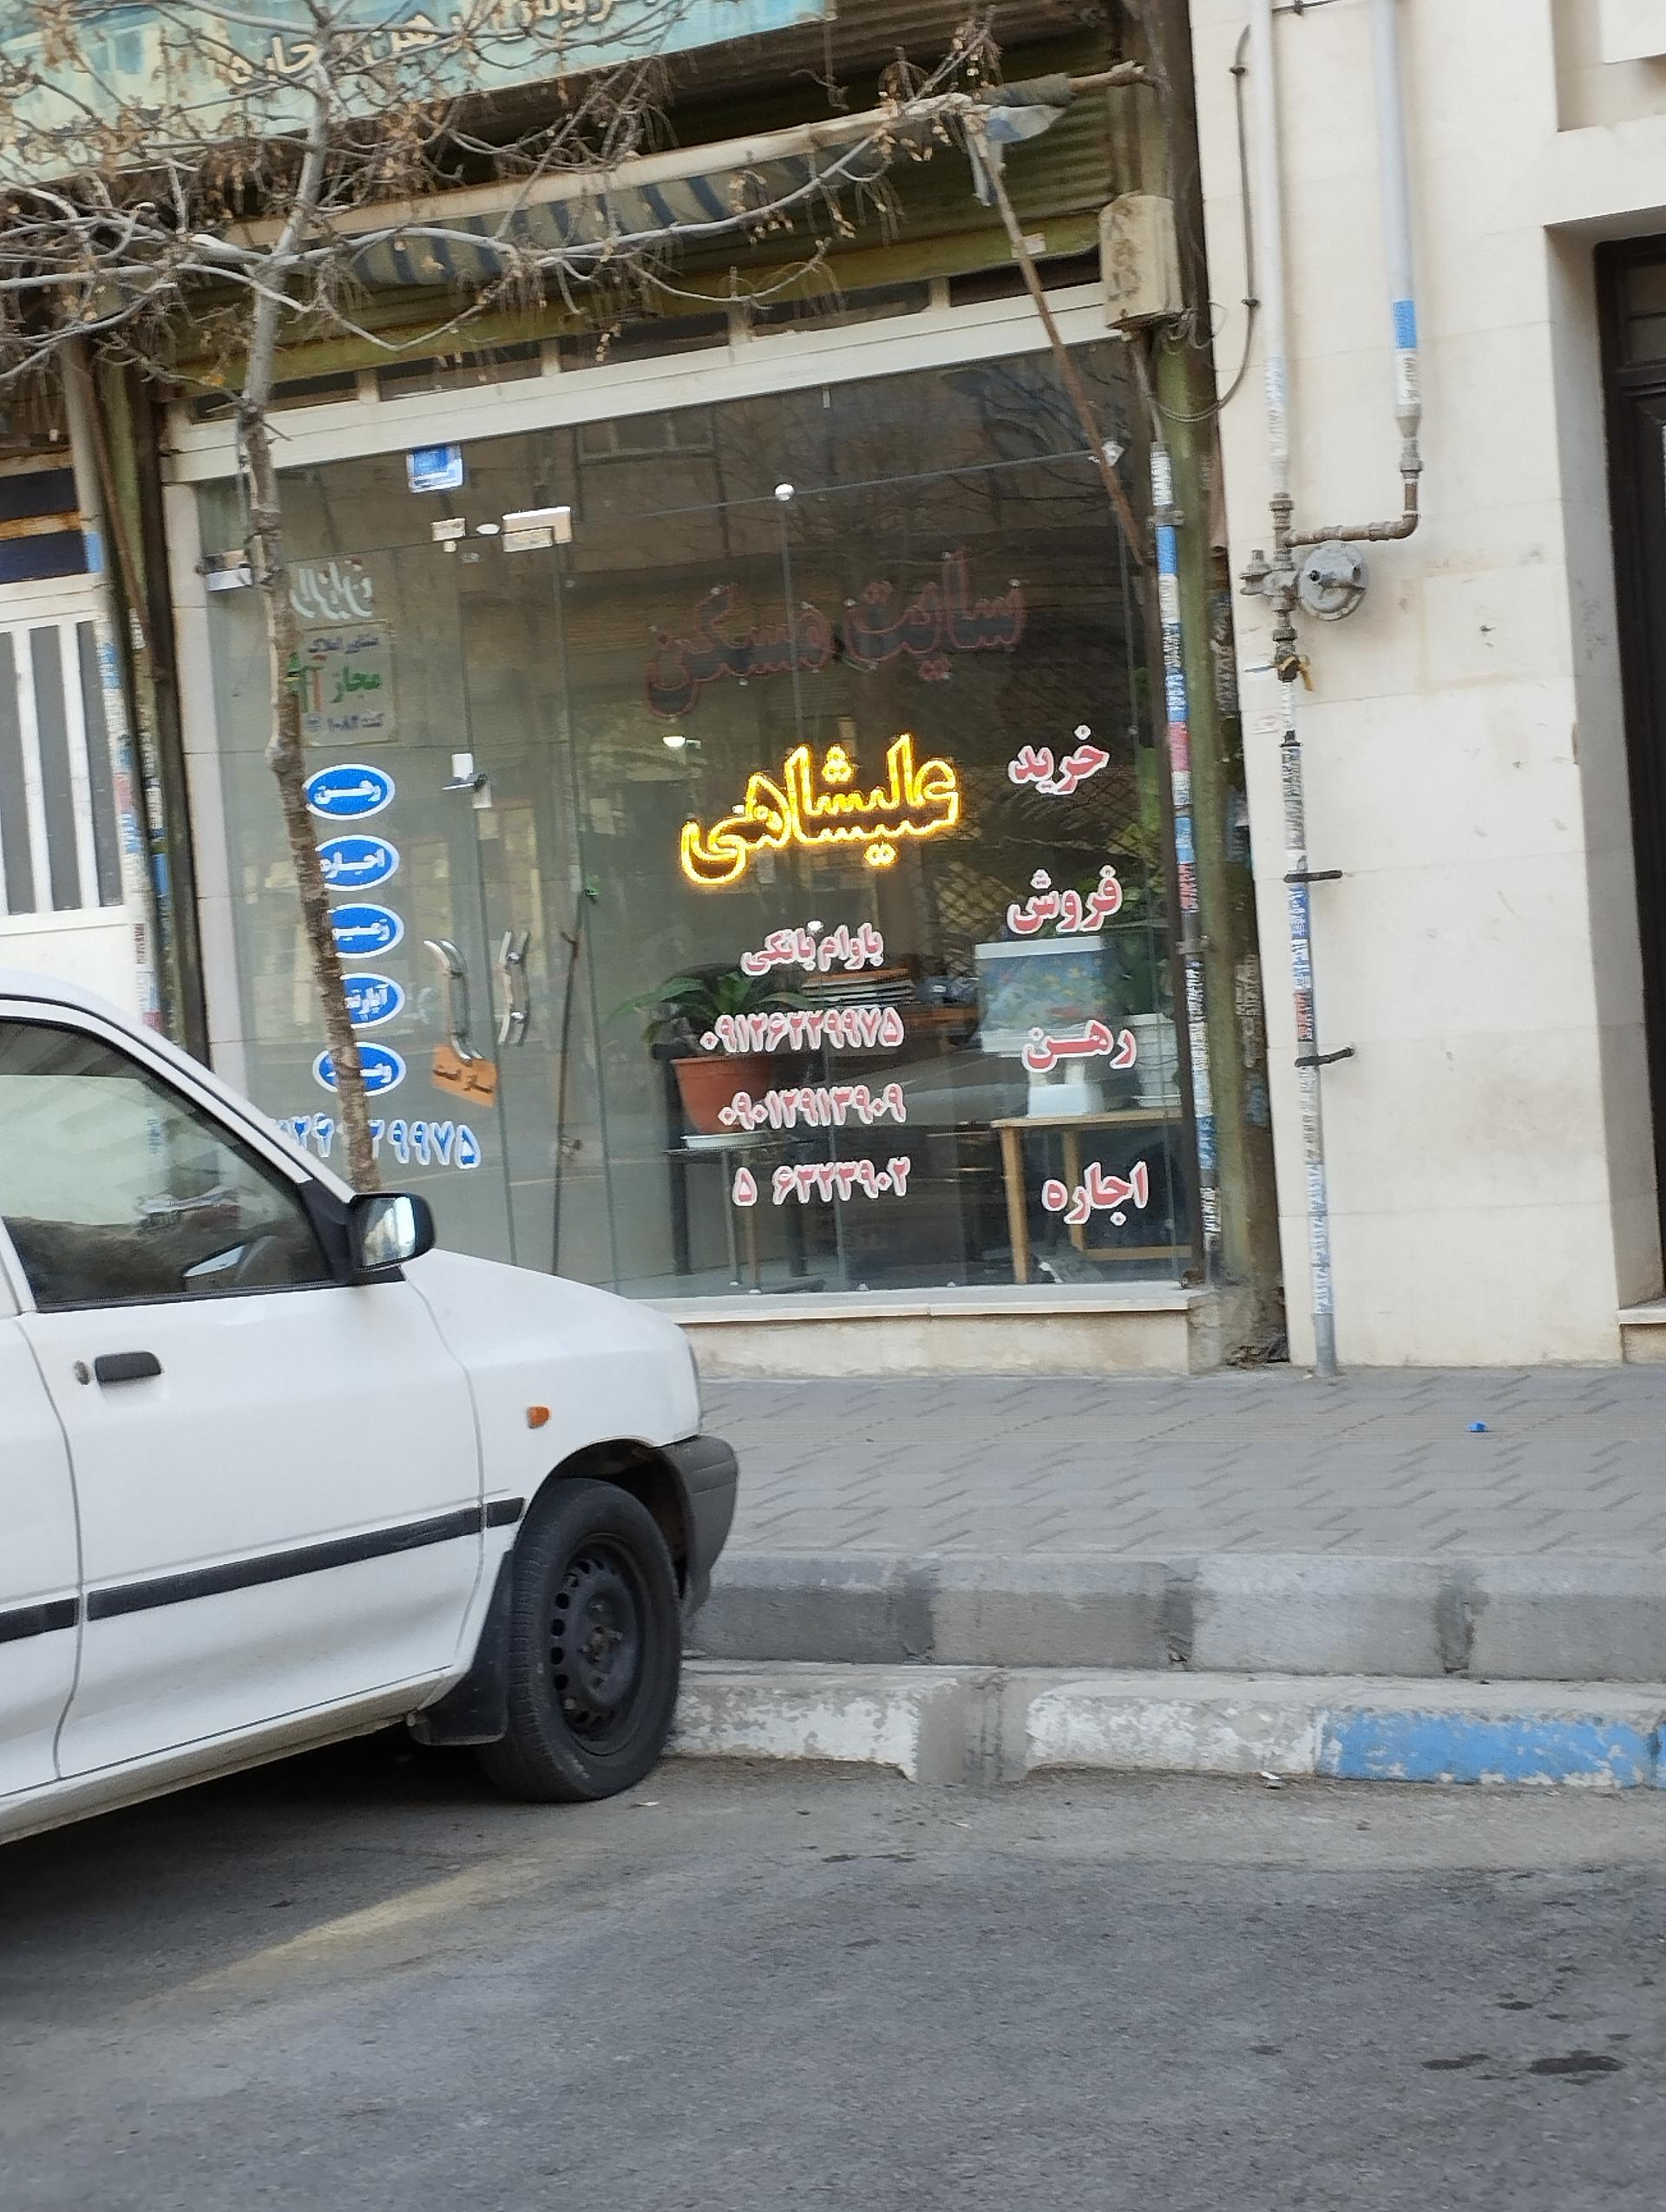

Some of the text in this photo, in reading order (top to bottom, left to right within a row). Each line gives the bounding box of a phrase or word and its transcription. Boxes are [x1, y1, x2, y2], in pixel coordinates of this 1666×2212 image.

[1008, 724, 1110, 795] خرید
[1007, 865, 1123, 934] فروش
[740, 927, 816, 976] بانکی
[1021, 1019, 1137, 1073] رهن
[1041, 1161, 1149, 1227] اجاره
